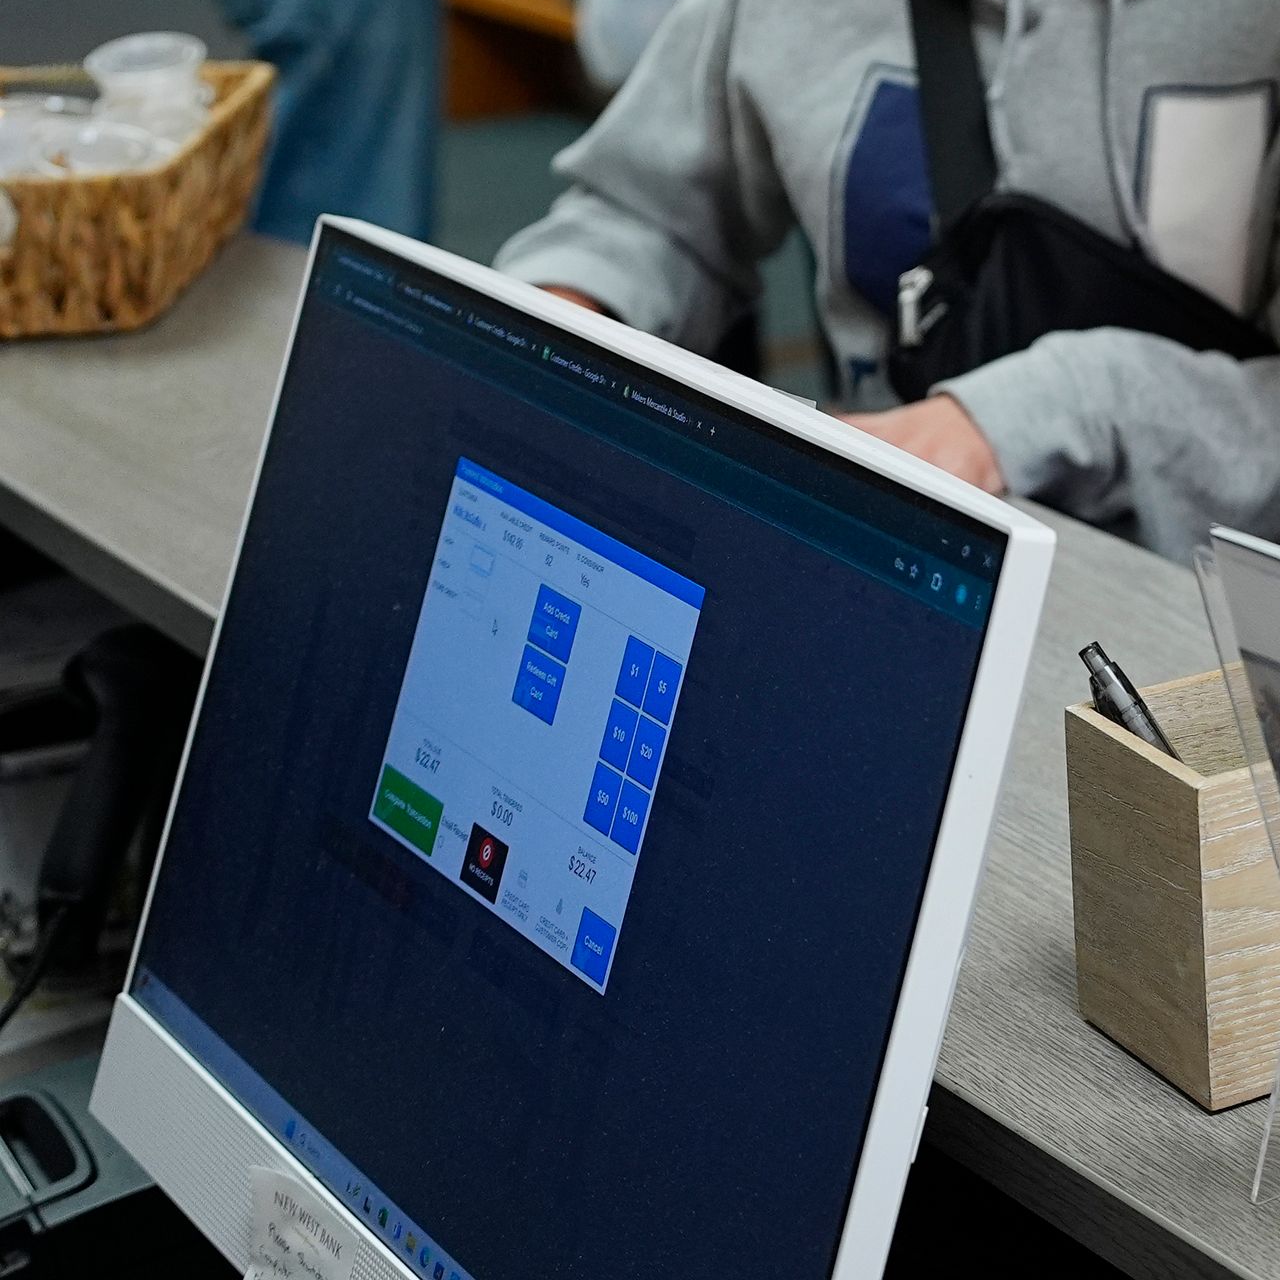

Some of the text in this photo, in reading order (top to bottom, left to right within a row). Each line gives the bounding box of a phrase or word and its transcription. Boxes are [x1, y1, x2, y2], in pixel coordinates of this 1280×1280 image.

[630, 663, 640, 678] $1
[657, 679, 668, 695] $5
[613, 725, 626, 743] $10
[640, 743, 653, 760] $20
[597, 789, 609, 806] $50
[622, 806, 638, 826] $100
[577, 845, 597, 865] BALANCE
[568, 855, 597, 885] $22.47
[584, 935, 603, 956] Cancel
[274, 1191, 299, 1217] NEW
[299, 1207, 320, 1236] WEST
[320, 1228, 343, 1261] BANK
